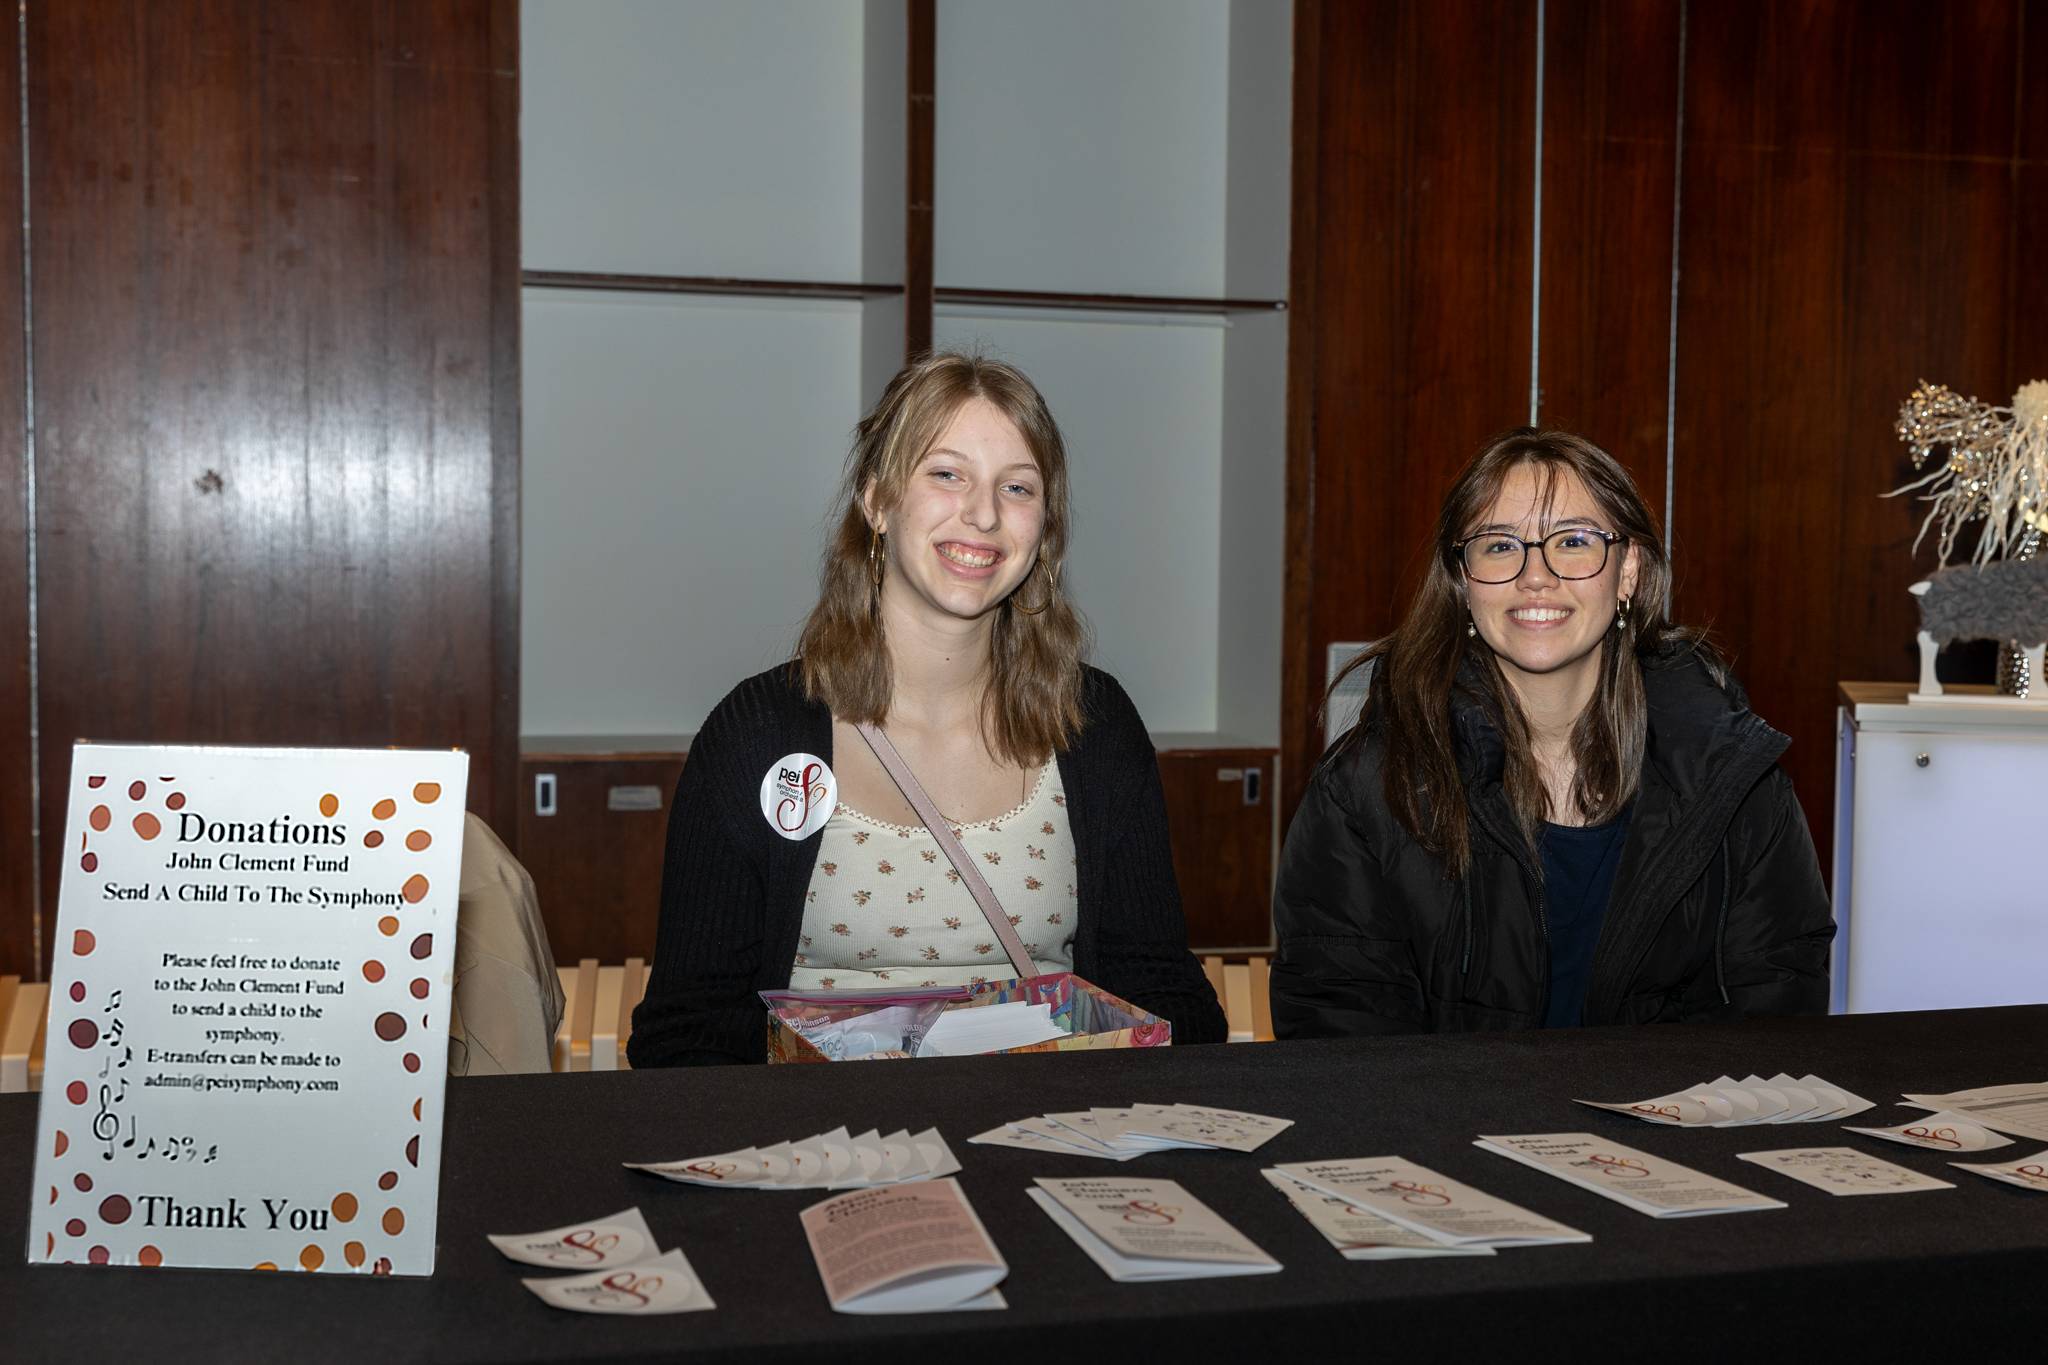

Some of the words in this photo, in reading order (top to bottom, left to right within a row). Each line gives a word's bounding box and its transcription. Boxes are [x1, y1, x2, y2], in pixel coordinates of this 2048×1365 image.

[779, 767, 802, 783] pei
[780, 790, 804, 802] orchesta
[177, 812, 347, 846] Donations
[165, 852, 212, 871] John
[219, 853, 295, 872] Clement
[303, 855, 349, 873] Fund
[103, 883, 149, 901] Send
[155, 885, 170, 901] A
[178, 884, 228, 902] Child
[234, 885, 260, 902] To
[266, 886, 303, 904] The
[308, 887, 407, 909] Symphony
[162, 953, 207, 968] Please
[210, 954, 236, 969] feel
[240, 954, 268, 969] free
[271, 957, 287, 970] to
[290, 956, 341, 971] donate
[154, 978, 170, 991] to
[173, 977, 197, 992] the
[200, 978, 236, 993] John
[239, 979, 301, 994] Clement
[305, 980, 345, 995] Fund
[172, 1003, 188, 1015] to
[191, 1002, 225, 1017] send
[228, 1006, 237, 1017] a
[240, 1003, 277, 1018] child
[280, 1005, 297, 1018] to
[300, 1003, 323, 1019] the
[205, 1026, 285, 1045] symphony.
[147, 1048, 227, 1065] E-transfers
[230, 1053, 256, 1065] can
[260, 1051, 279, 1066] be
[281, 1051, 321, 1067] made
[325, 1054, 341, 1067] to
[144, 1072, 339, 1094] admin@peisymphony.com
[138, 1196, 247, 1230] Thank
[261, 1198, 330, 1231] You
